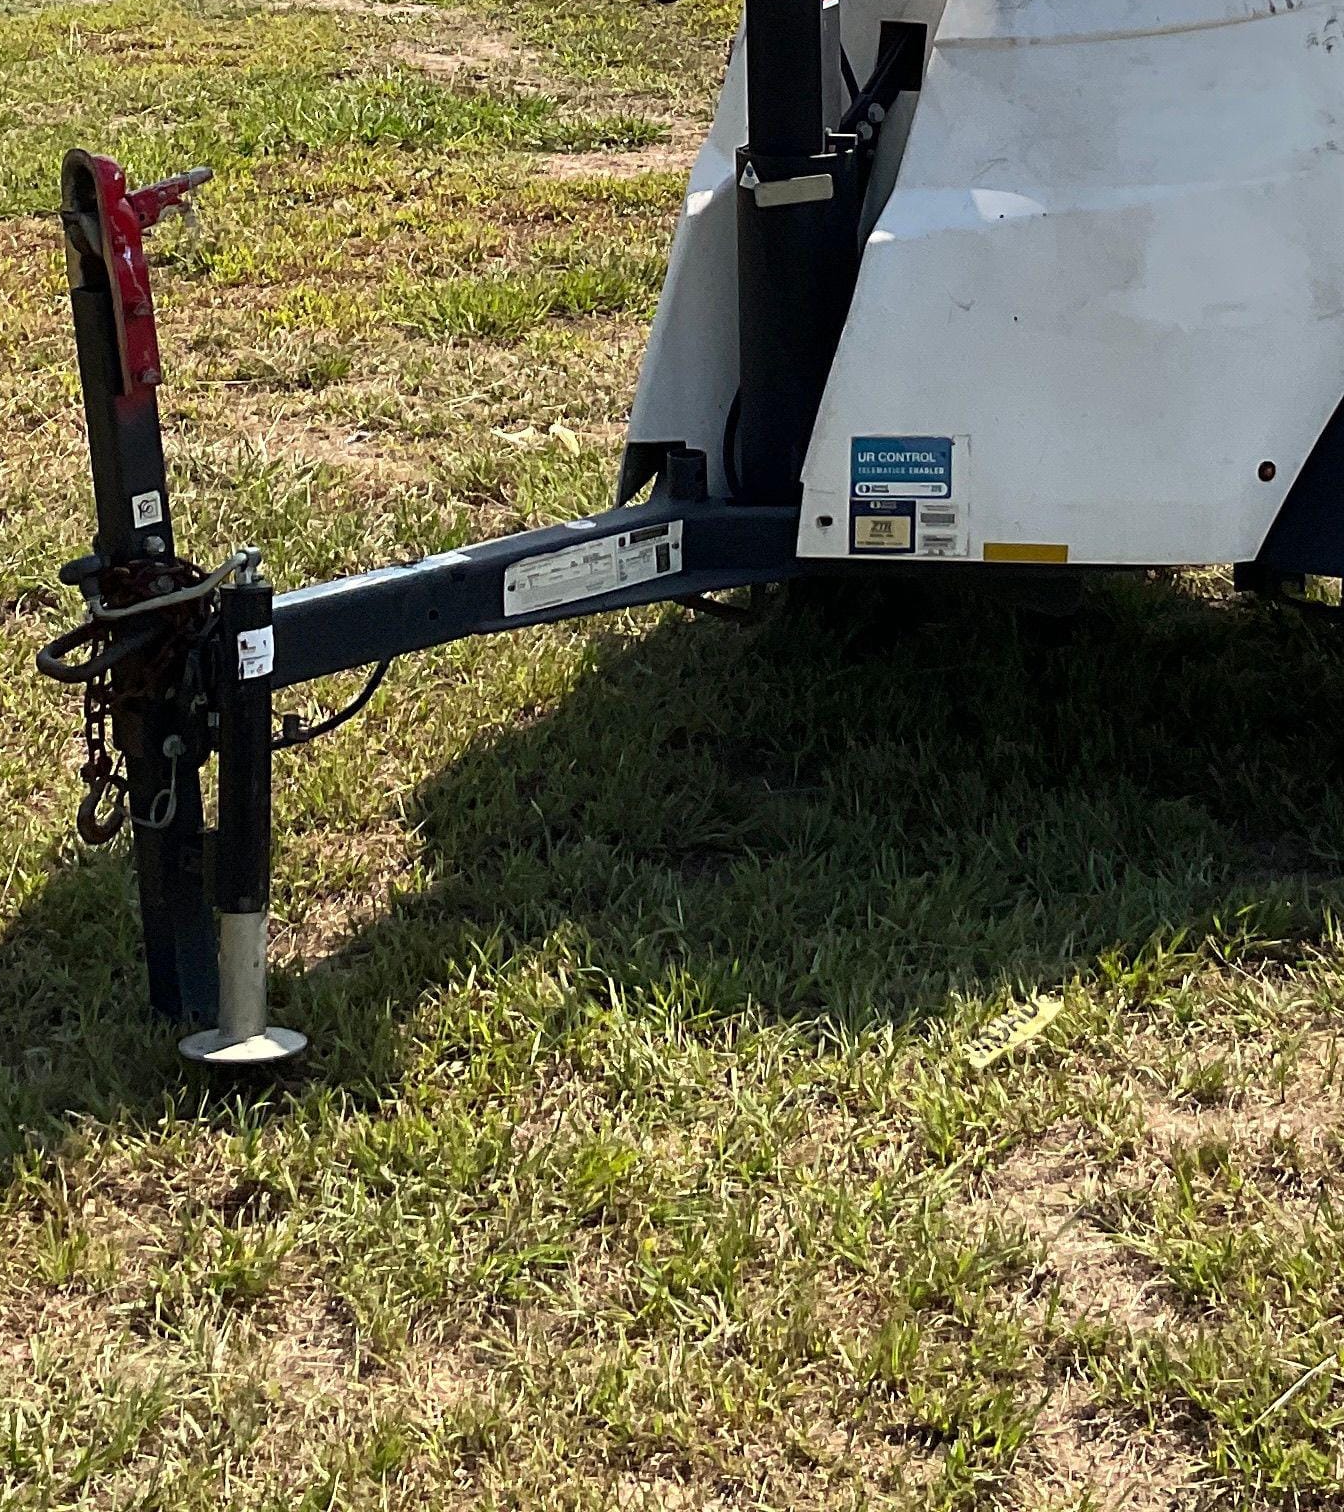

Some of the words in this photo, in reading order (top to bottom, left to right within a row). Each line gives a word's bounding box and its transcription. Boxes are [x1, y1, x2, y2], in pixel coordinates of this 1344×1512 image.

[857, 452, 875, 463] UR
[878, 452, 937, 463] CONTROL
[908, 467, 945, 475] ENABLED
